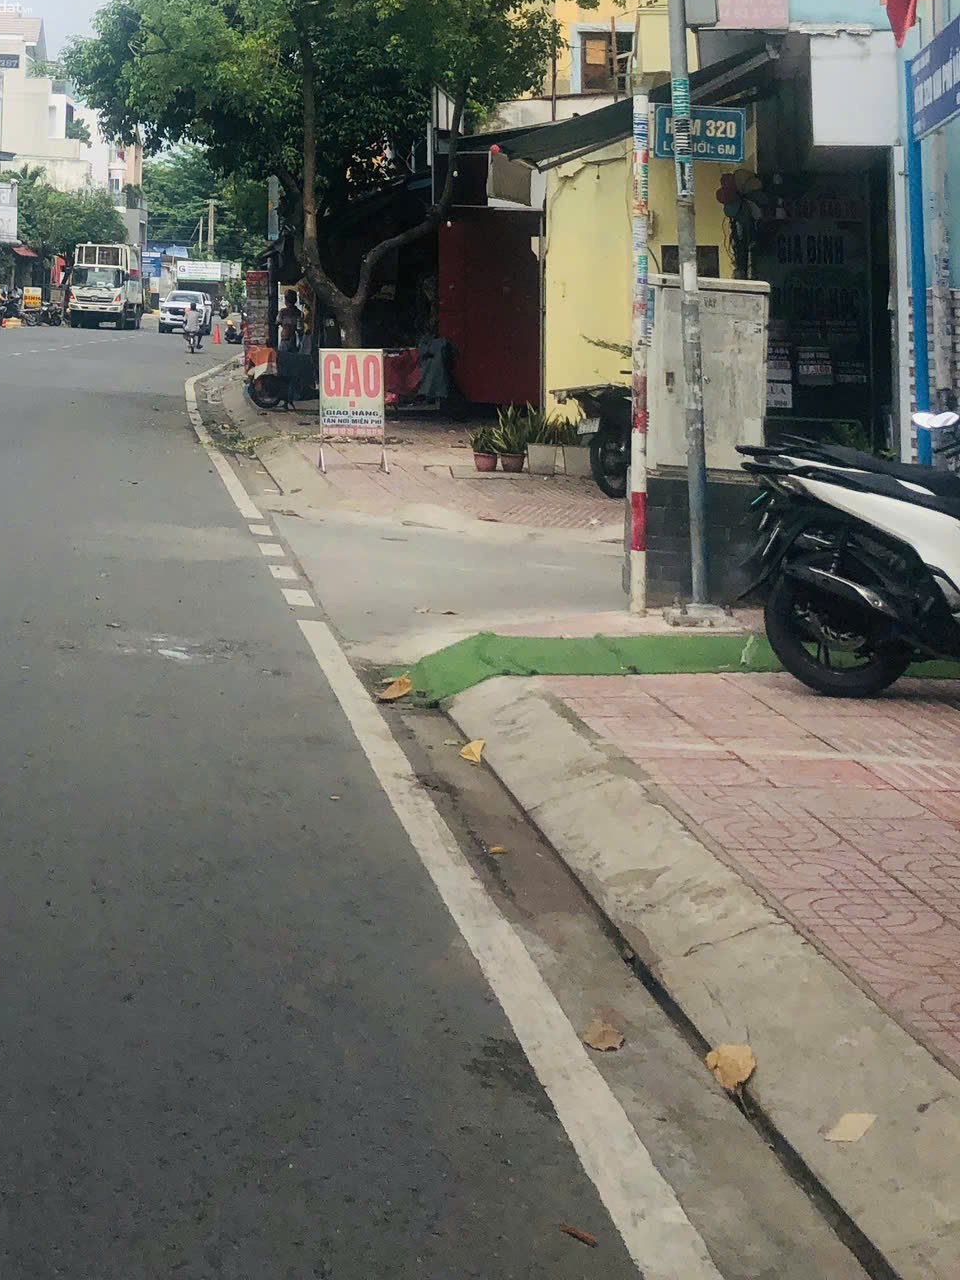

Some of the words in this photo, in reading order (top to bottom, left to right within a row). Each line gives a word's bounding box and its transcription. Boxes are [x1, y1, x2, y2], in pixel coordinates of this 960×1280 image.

[665, 117, 701, 137] HM
[706, 119, 737, 139] 320
[693, 140, 715, 154] IỚI:
[717, 144, 736, 156] 6M
[323, 353, 381, 408] GẠO
